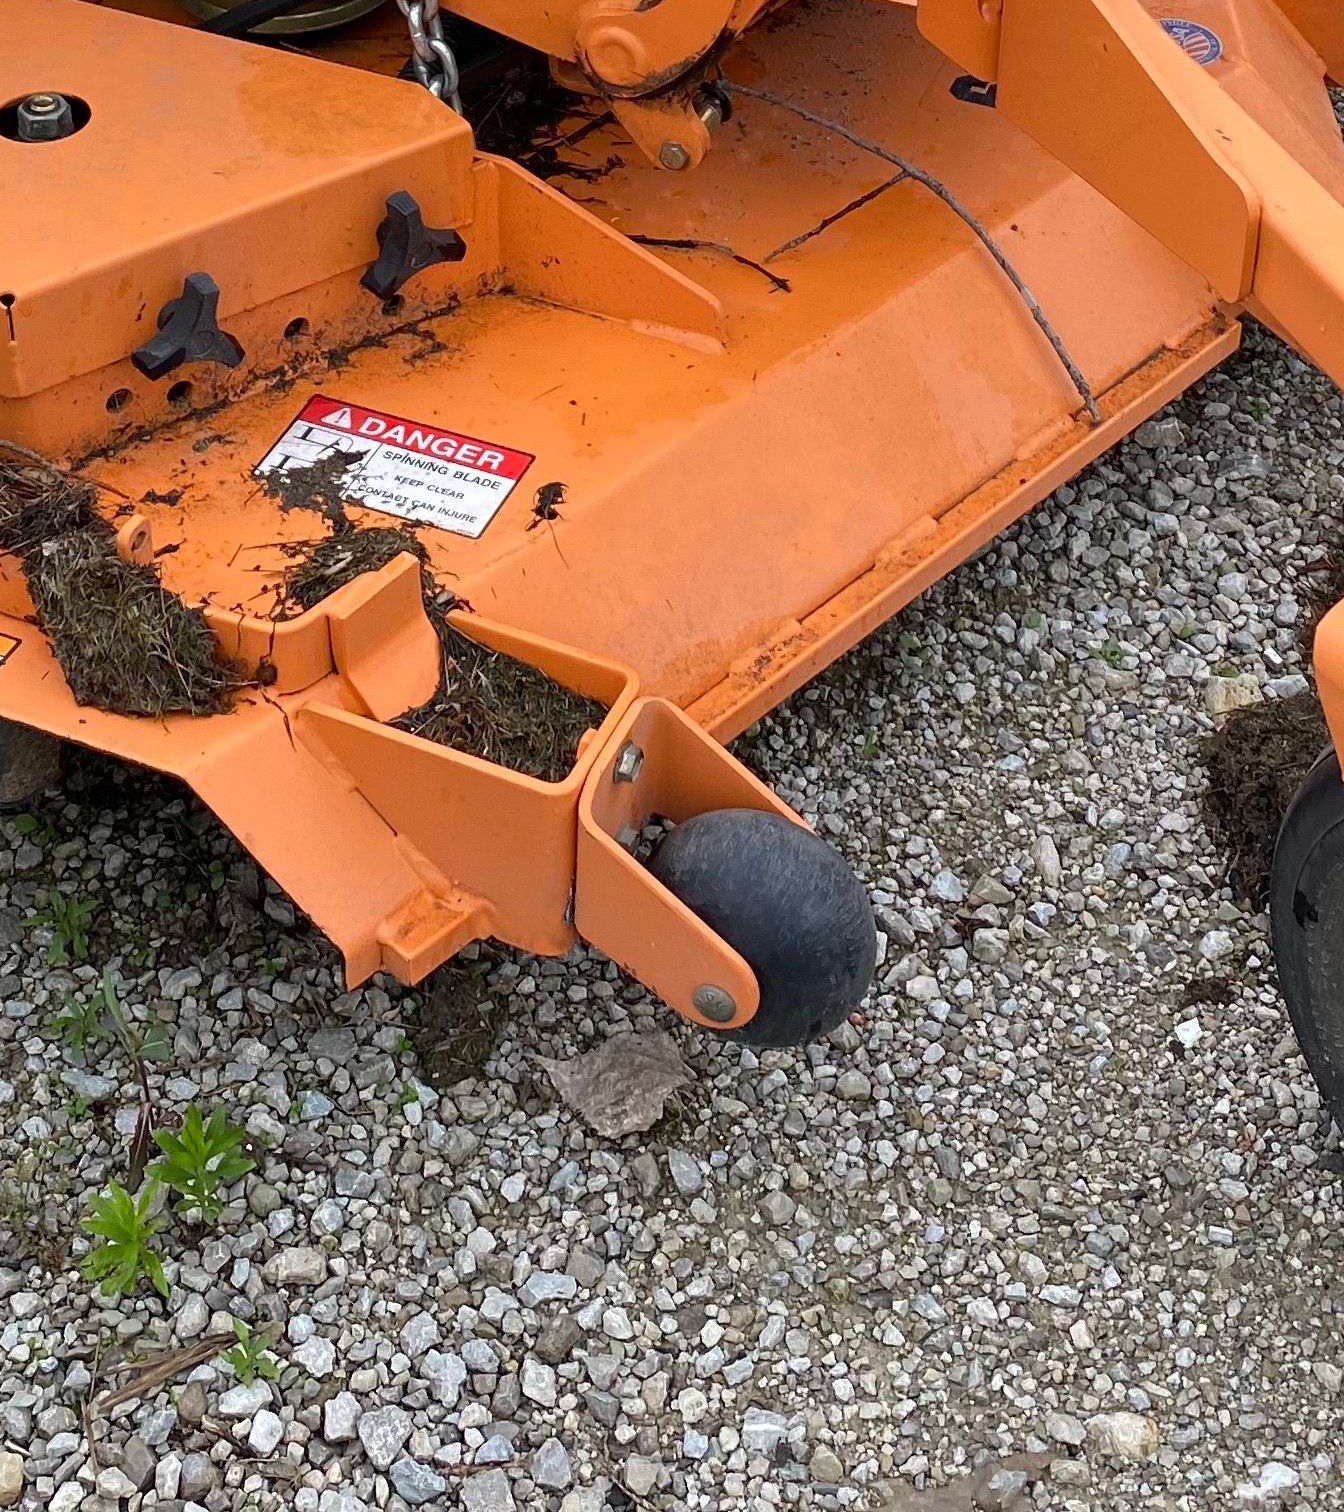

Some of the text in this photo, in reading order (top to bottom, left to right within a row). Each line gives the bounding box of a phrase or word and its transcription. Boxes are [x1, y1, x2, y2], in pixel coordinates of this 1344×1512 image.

[358, 416, 505, 471] DANGER
[382, 450, 502, 491] SPINNING BLADE
[394, 474, 465, 500] KEEP CLEAR
[357, 484, 478, 524] CONTACT CAN INJURE
